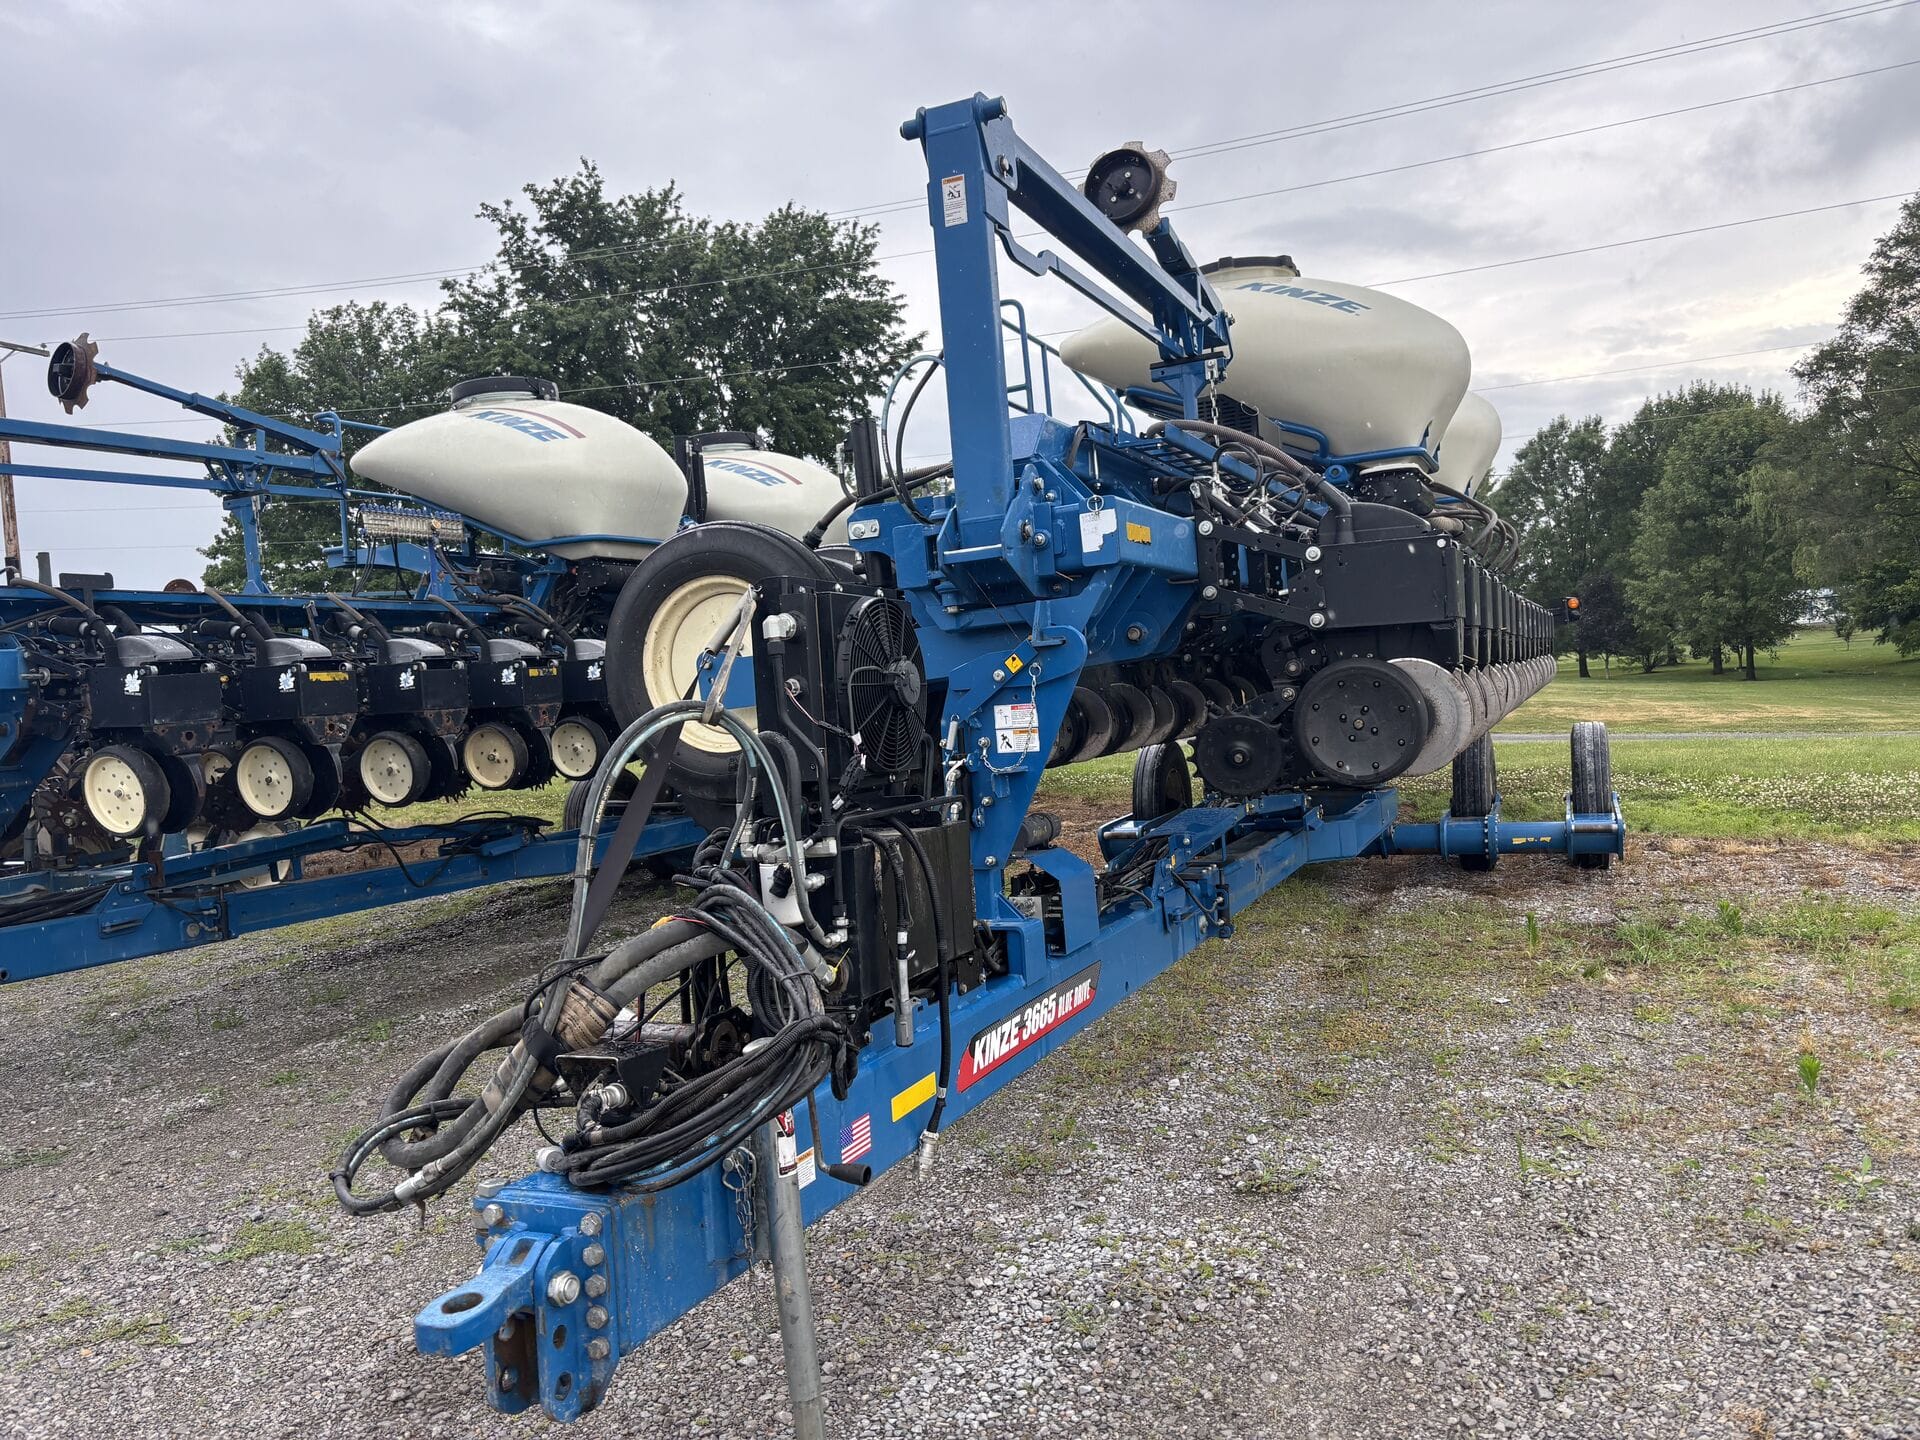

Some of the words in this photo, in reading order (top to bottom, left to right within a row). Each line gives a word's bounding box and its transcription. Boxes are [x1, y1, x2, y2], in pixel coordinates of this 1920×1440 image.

[1234, 282, 1372, 314] KINZE
[466, 410, 569, 442] KINZE
[704, 460, 786, 487] KINZE
[972, 1014, 1021, 1075] KINZE
[1022, 992, 1057, 1040] 3665
